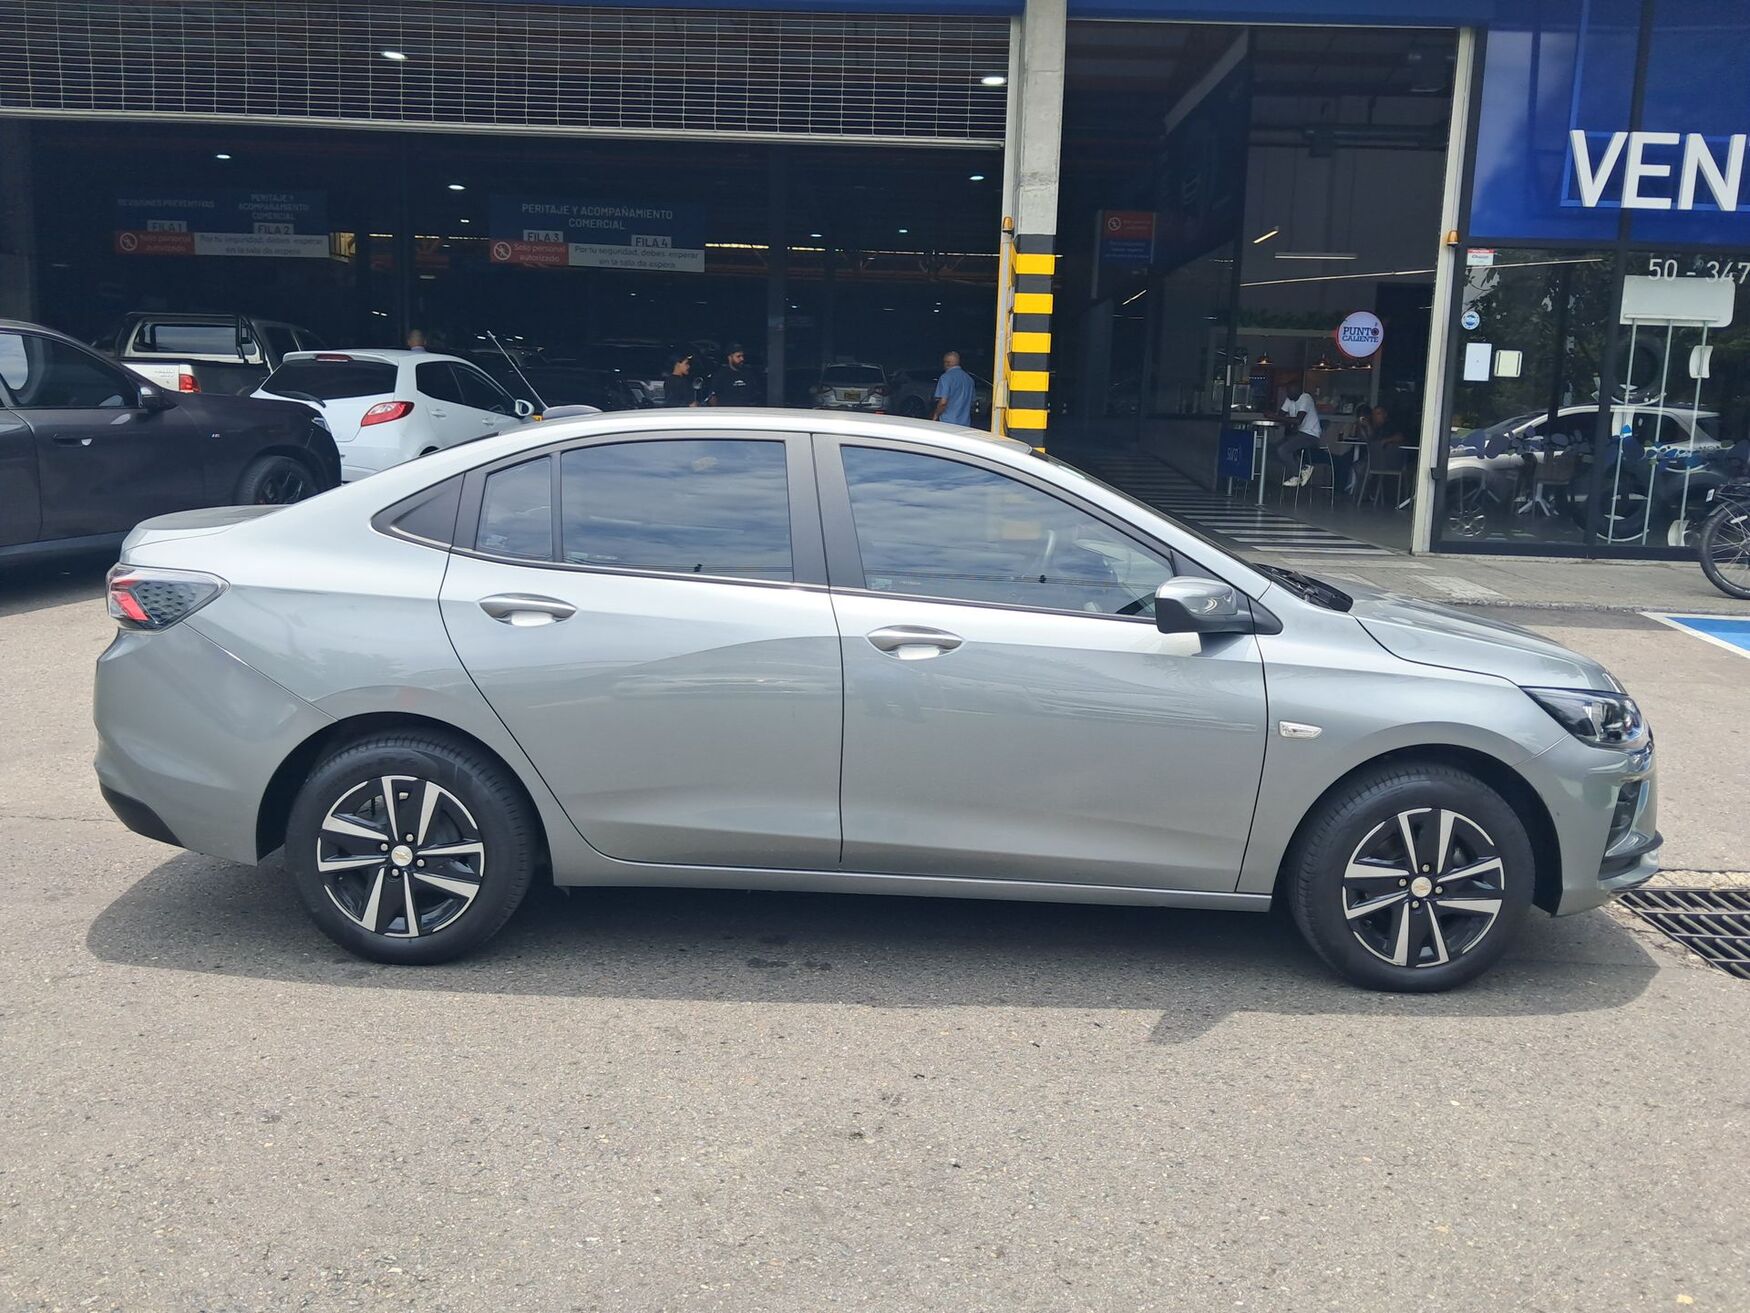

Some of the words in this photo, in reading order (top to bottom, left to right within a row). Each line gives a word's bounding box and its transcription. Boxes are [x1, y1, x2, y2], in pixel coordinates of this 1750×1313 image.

[521, 203, 569, 215] PERITAJE
[572, 205, 580, 216] Y
[580, 205, 673, 220] ACOMPAÑAMIENTO
[151, 222, 176, 232] FILA
[568, 217, 626, 231] COMERCIAL
[257, 225, 281, 234] FILA
[283, 226, 290, 235] 2
[527, 231, 551, 242] FILA
[553, 232, 560, 242] 3
[635, 236, 660, 248] FILA
[661, 238, 669, 248] 4
[1648, 258, 1678, 281] 50
[1706, 260, 1750, 285] 347
[1344, 326, 1380, 336] PUNTO
[1342, 334, 1379, 343] CALIENTE
